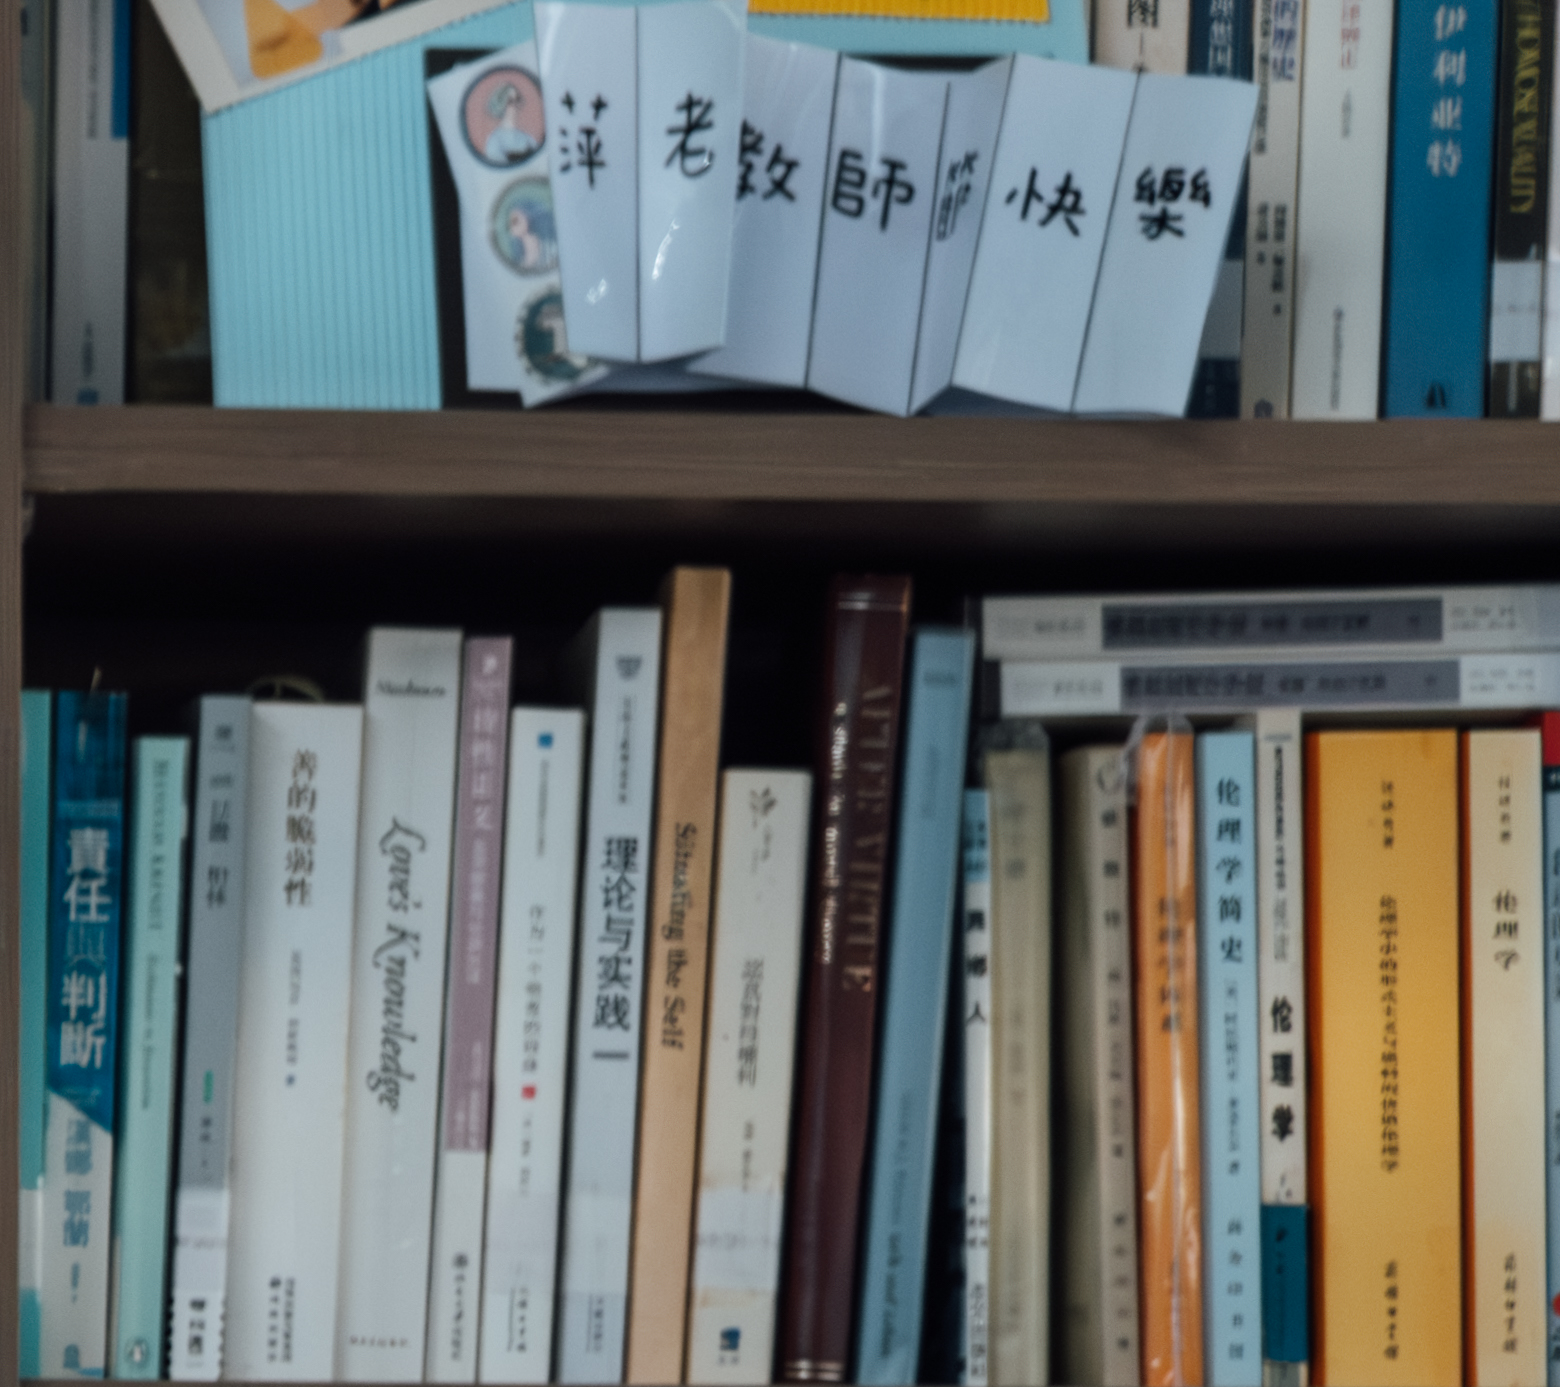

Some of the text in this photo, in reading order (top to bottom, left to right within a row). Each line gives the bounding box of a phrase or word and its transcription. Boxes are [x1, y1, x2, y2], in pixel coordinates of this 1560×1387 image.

[1427, 4, 1467, 177] 伊利亚特
[284, 747, 318, 908] 善的脆弱性
[1216, 776, 1245, 964] 伦理学简史
[60, 827, 110, 1068] 責任與判斷
[366, 817, 426, 1113] Love's Knowledge
[592, 835, 639, 1032] 理论与实践
[661, 822, 698, 1052] Situating the Self
[1269, 995, 1295, 1143] 伦理学
